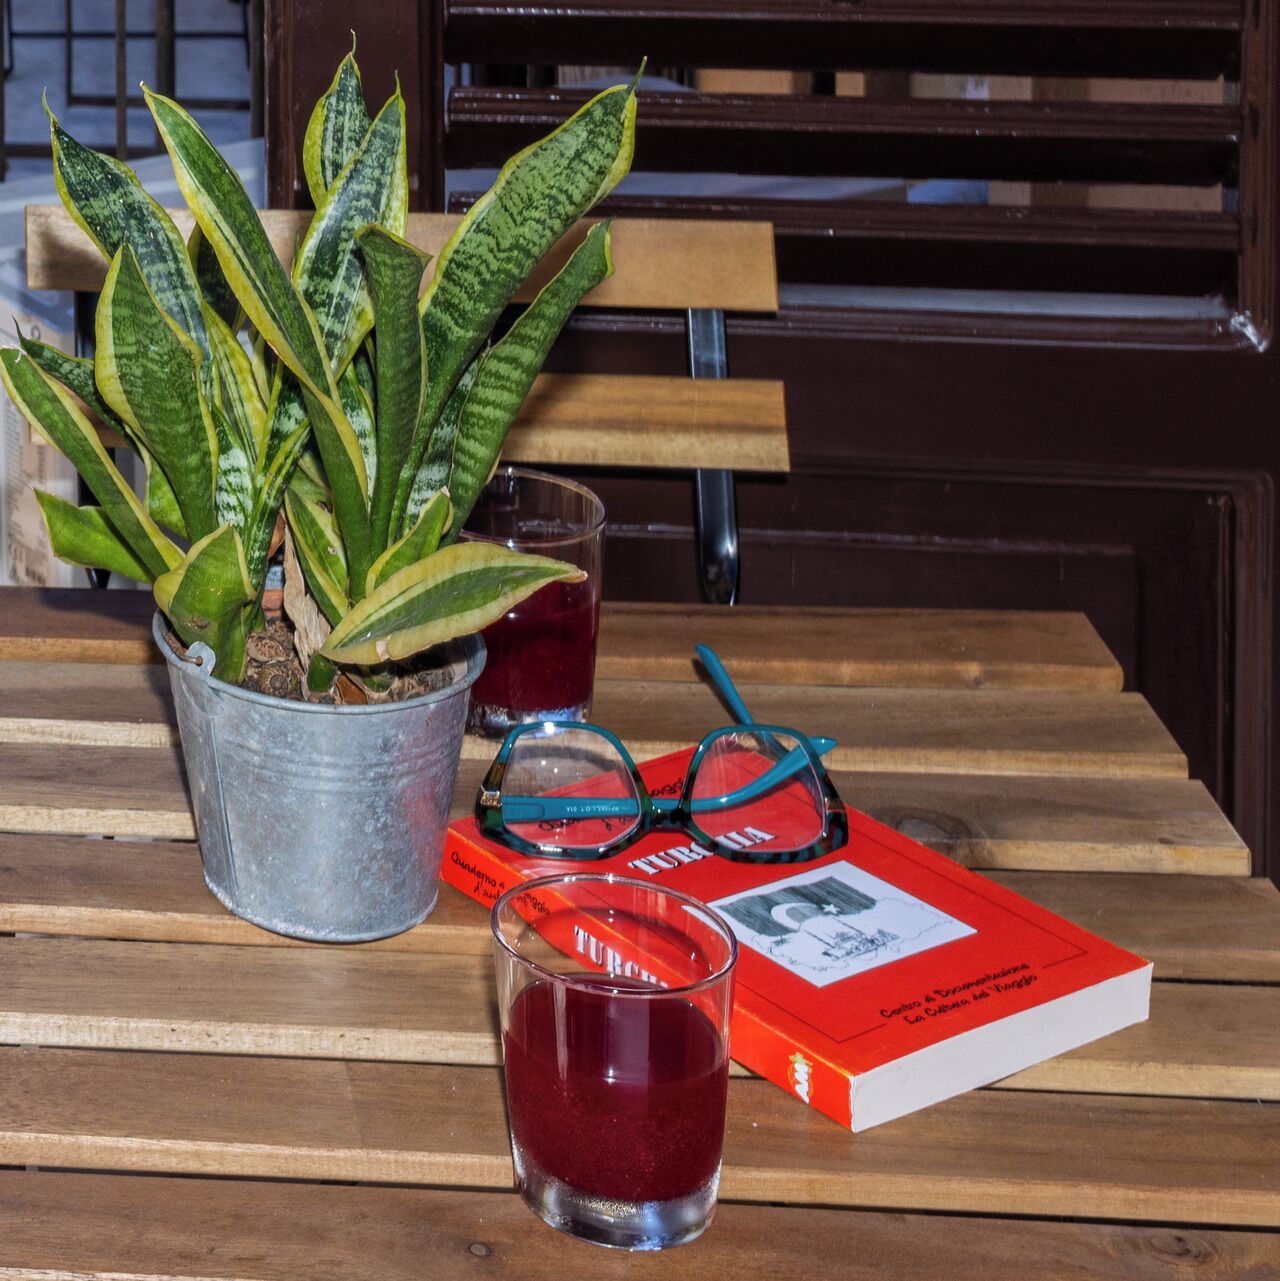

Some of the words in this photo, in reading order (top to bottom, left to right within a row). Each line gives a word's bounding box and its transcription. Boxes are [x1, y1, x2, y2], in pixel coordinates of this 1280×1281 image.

[451, 851, 497, 888] Quaderno
[880, 1001, 921, 1018] Centro
[933, 963, 1030, 997] Documentazione
[903, 1015, 925, 1024] La
[924, 999, 970, 1017] Cultura
[988, 975, 1037, 992] Viaggio
